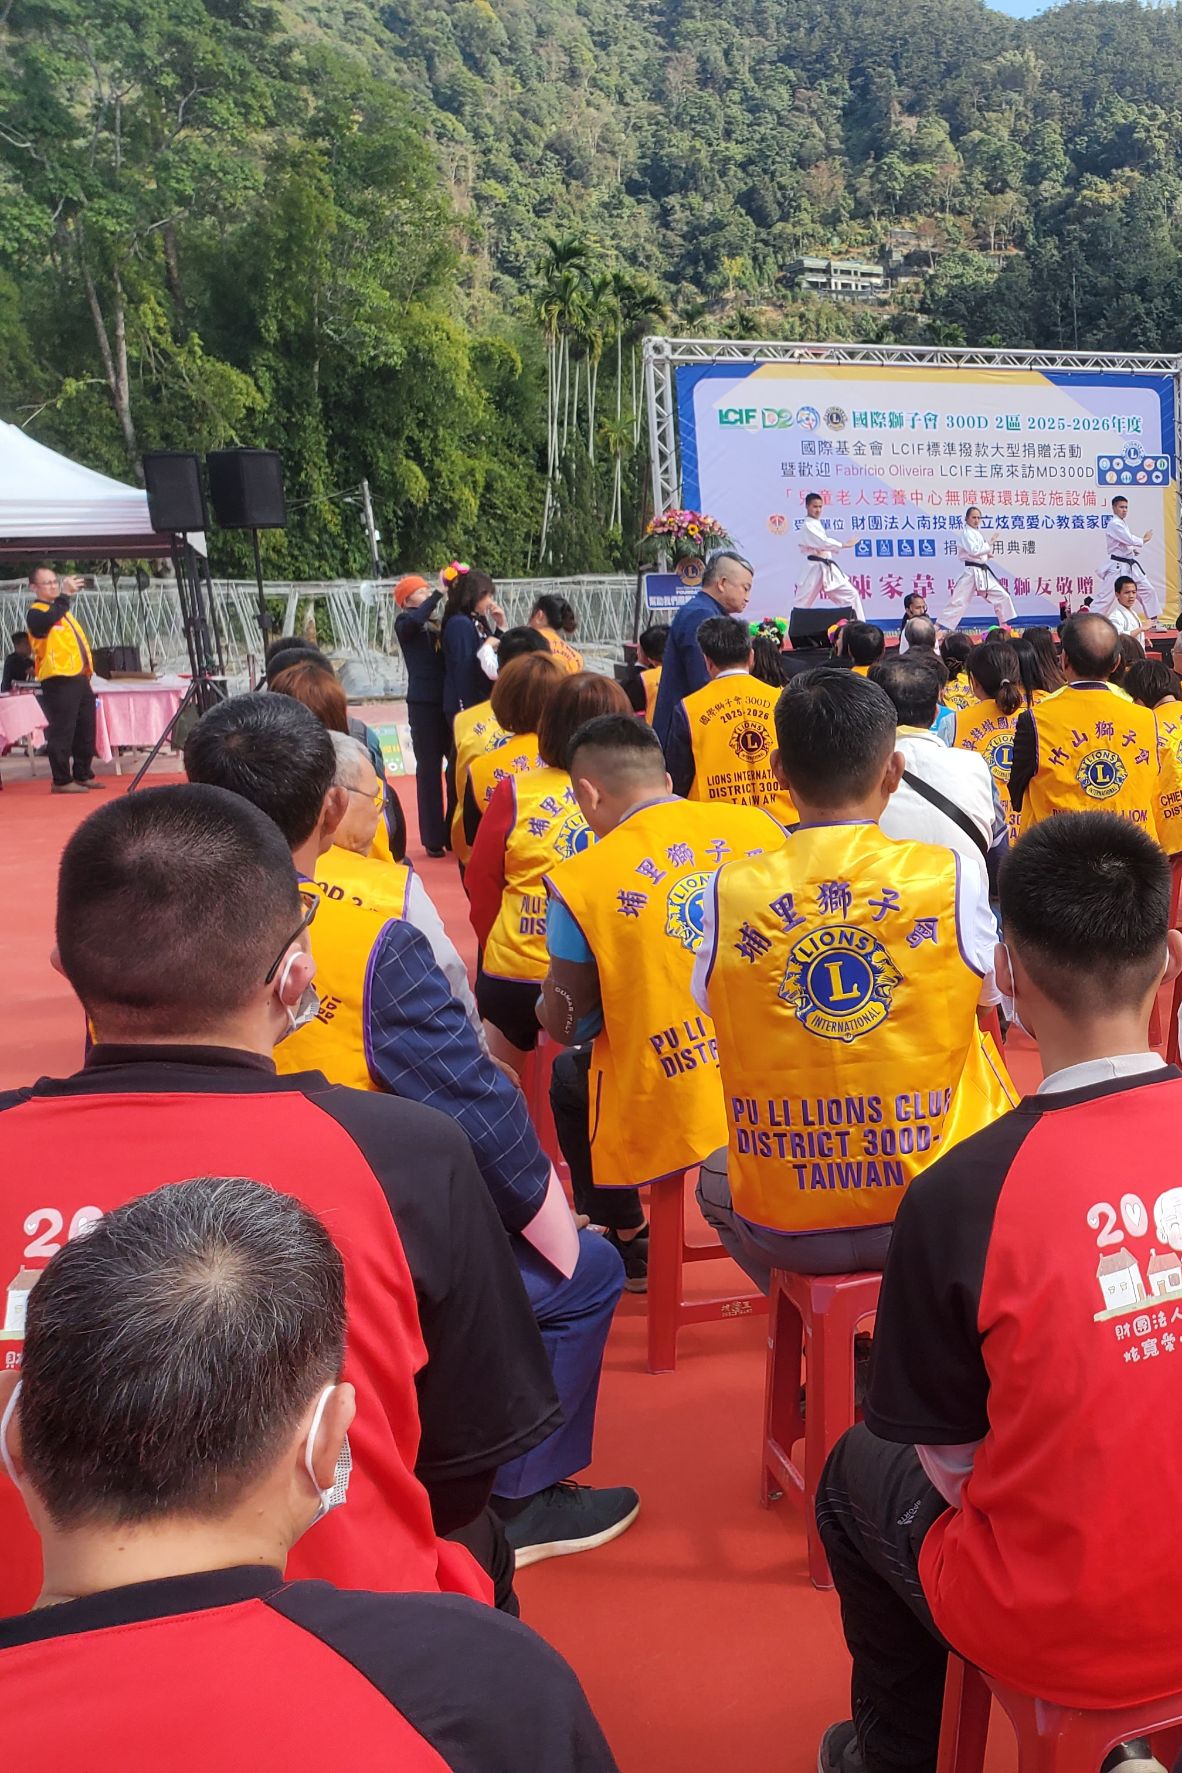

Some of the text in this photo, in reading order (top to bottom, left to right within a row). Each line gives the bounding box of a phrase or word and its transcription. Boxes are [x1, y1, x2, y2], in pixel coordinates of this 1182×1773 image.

[718, 408, 757, 425] LCIF
[852, 410, 1142, 434] 國際獅子會 300D 2區 2025-2026年度
[801, 440, 1082, 459] 國際基金會 LCIF標準撥款大型捐贈活動
[781, 462, 1095, 479] 暨歡迎 Fabricio Oliveira LCIF主席來訪MD300D
[851, 515, 1114, 531] 財團法人南投縣立炫寬愛心教養家園
[745, 696, 771, 709] 300D
[720, 708, 769, 724] 2025-2026
[737, 722, 762, 733] LIONS
[746, 733, 758, 749] L
[993, 736, 1015, 746] LION
[1048, 721, 1150, 767] 竹山獅子會
[1086, 751, 1117, 763] LIONS
[707, 769, 775, 786] LIONS INTERNATI
[1096, 764, 1110, 783] L
[709, 781, 781, 798] DISTRICT 300
[732, 793, 776, 806] TAIWAN
[673, 874, 711, 900] LION
[734, 880, 940, 963] 埔里獅子會
[802, 930, 870, 959] LIONS
[824, 961, 861, 1002] L
[811, 1007, 882, 1033] INTERNATIONAL
[649, 1016, 705, 1056] PU LI
[660, 1038, 719, 1079] DISTR
[731, 1097, 759, 1125] PU
[768, 1097, 791, 1127] LI
[801, 1095, 883, 1127] LIONS
[736, 1125, 944, 1159] DISTRICT 300D-
[792, 1160, 905, 1190] TAIWAN
[1086, 1192, 1149, 1248] 20
